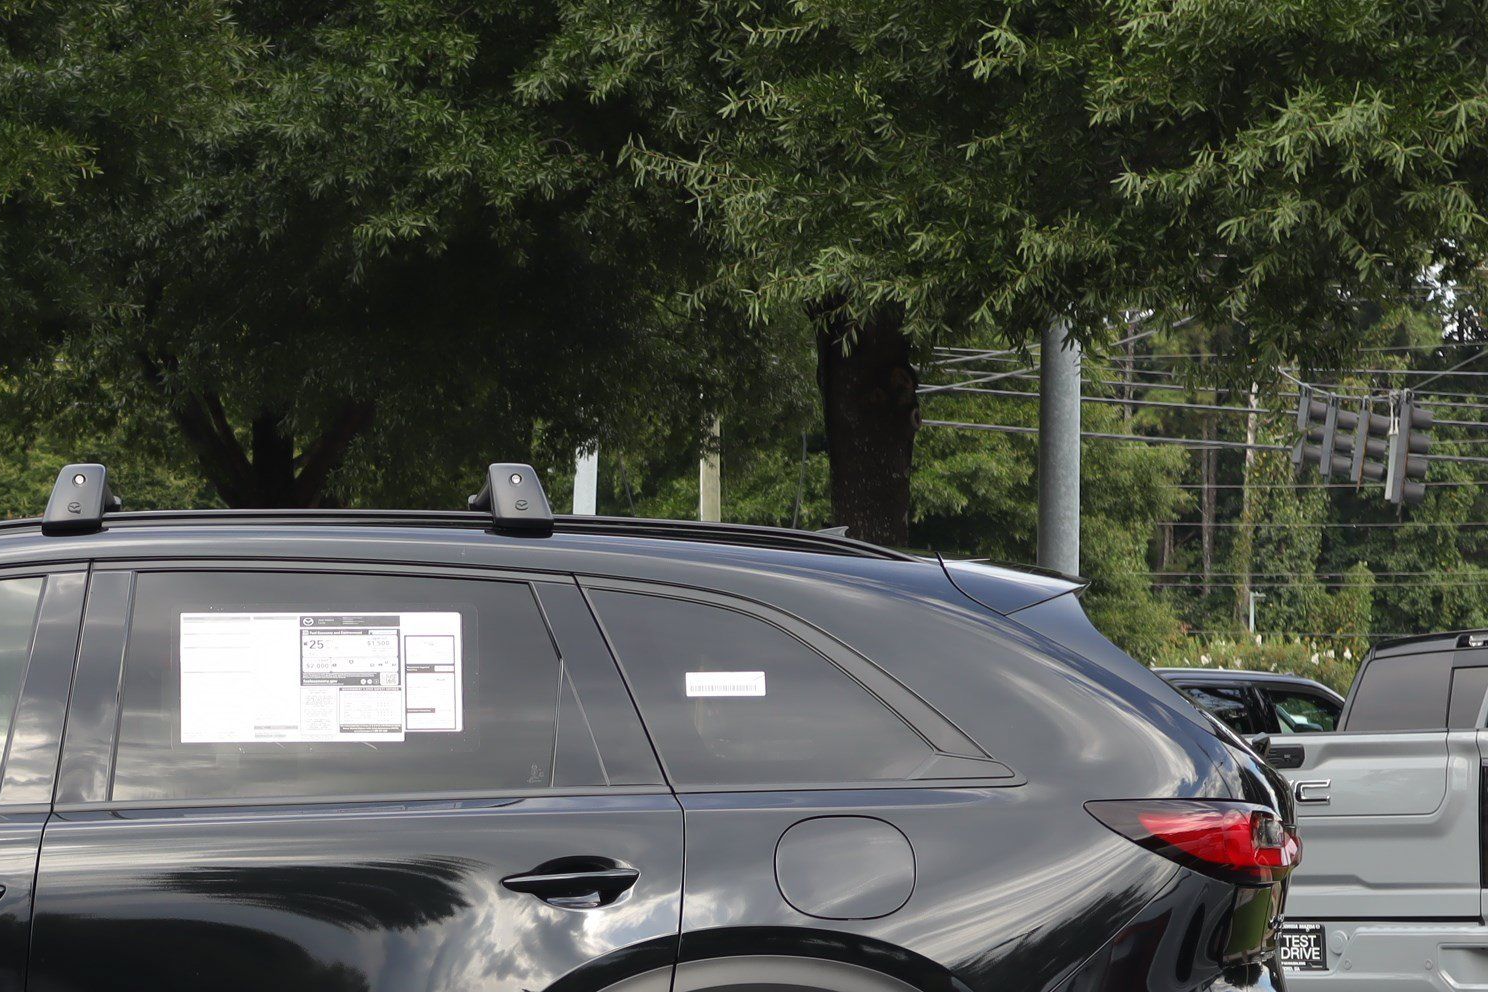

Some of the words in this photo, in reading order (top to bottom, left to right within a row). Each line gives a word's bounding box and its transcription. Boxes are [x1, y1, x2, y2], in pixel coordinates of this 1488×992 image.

[309, 639, 324, 650] 25
[1283, 935, 1316, 947] TEST
[1281, 947, 1320, 960] DRIVE
